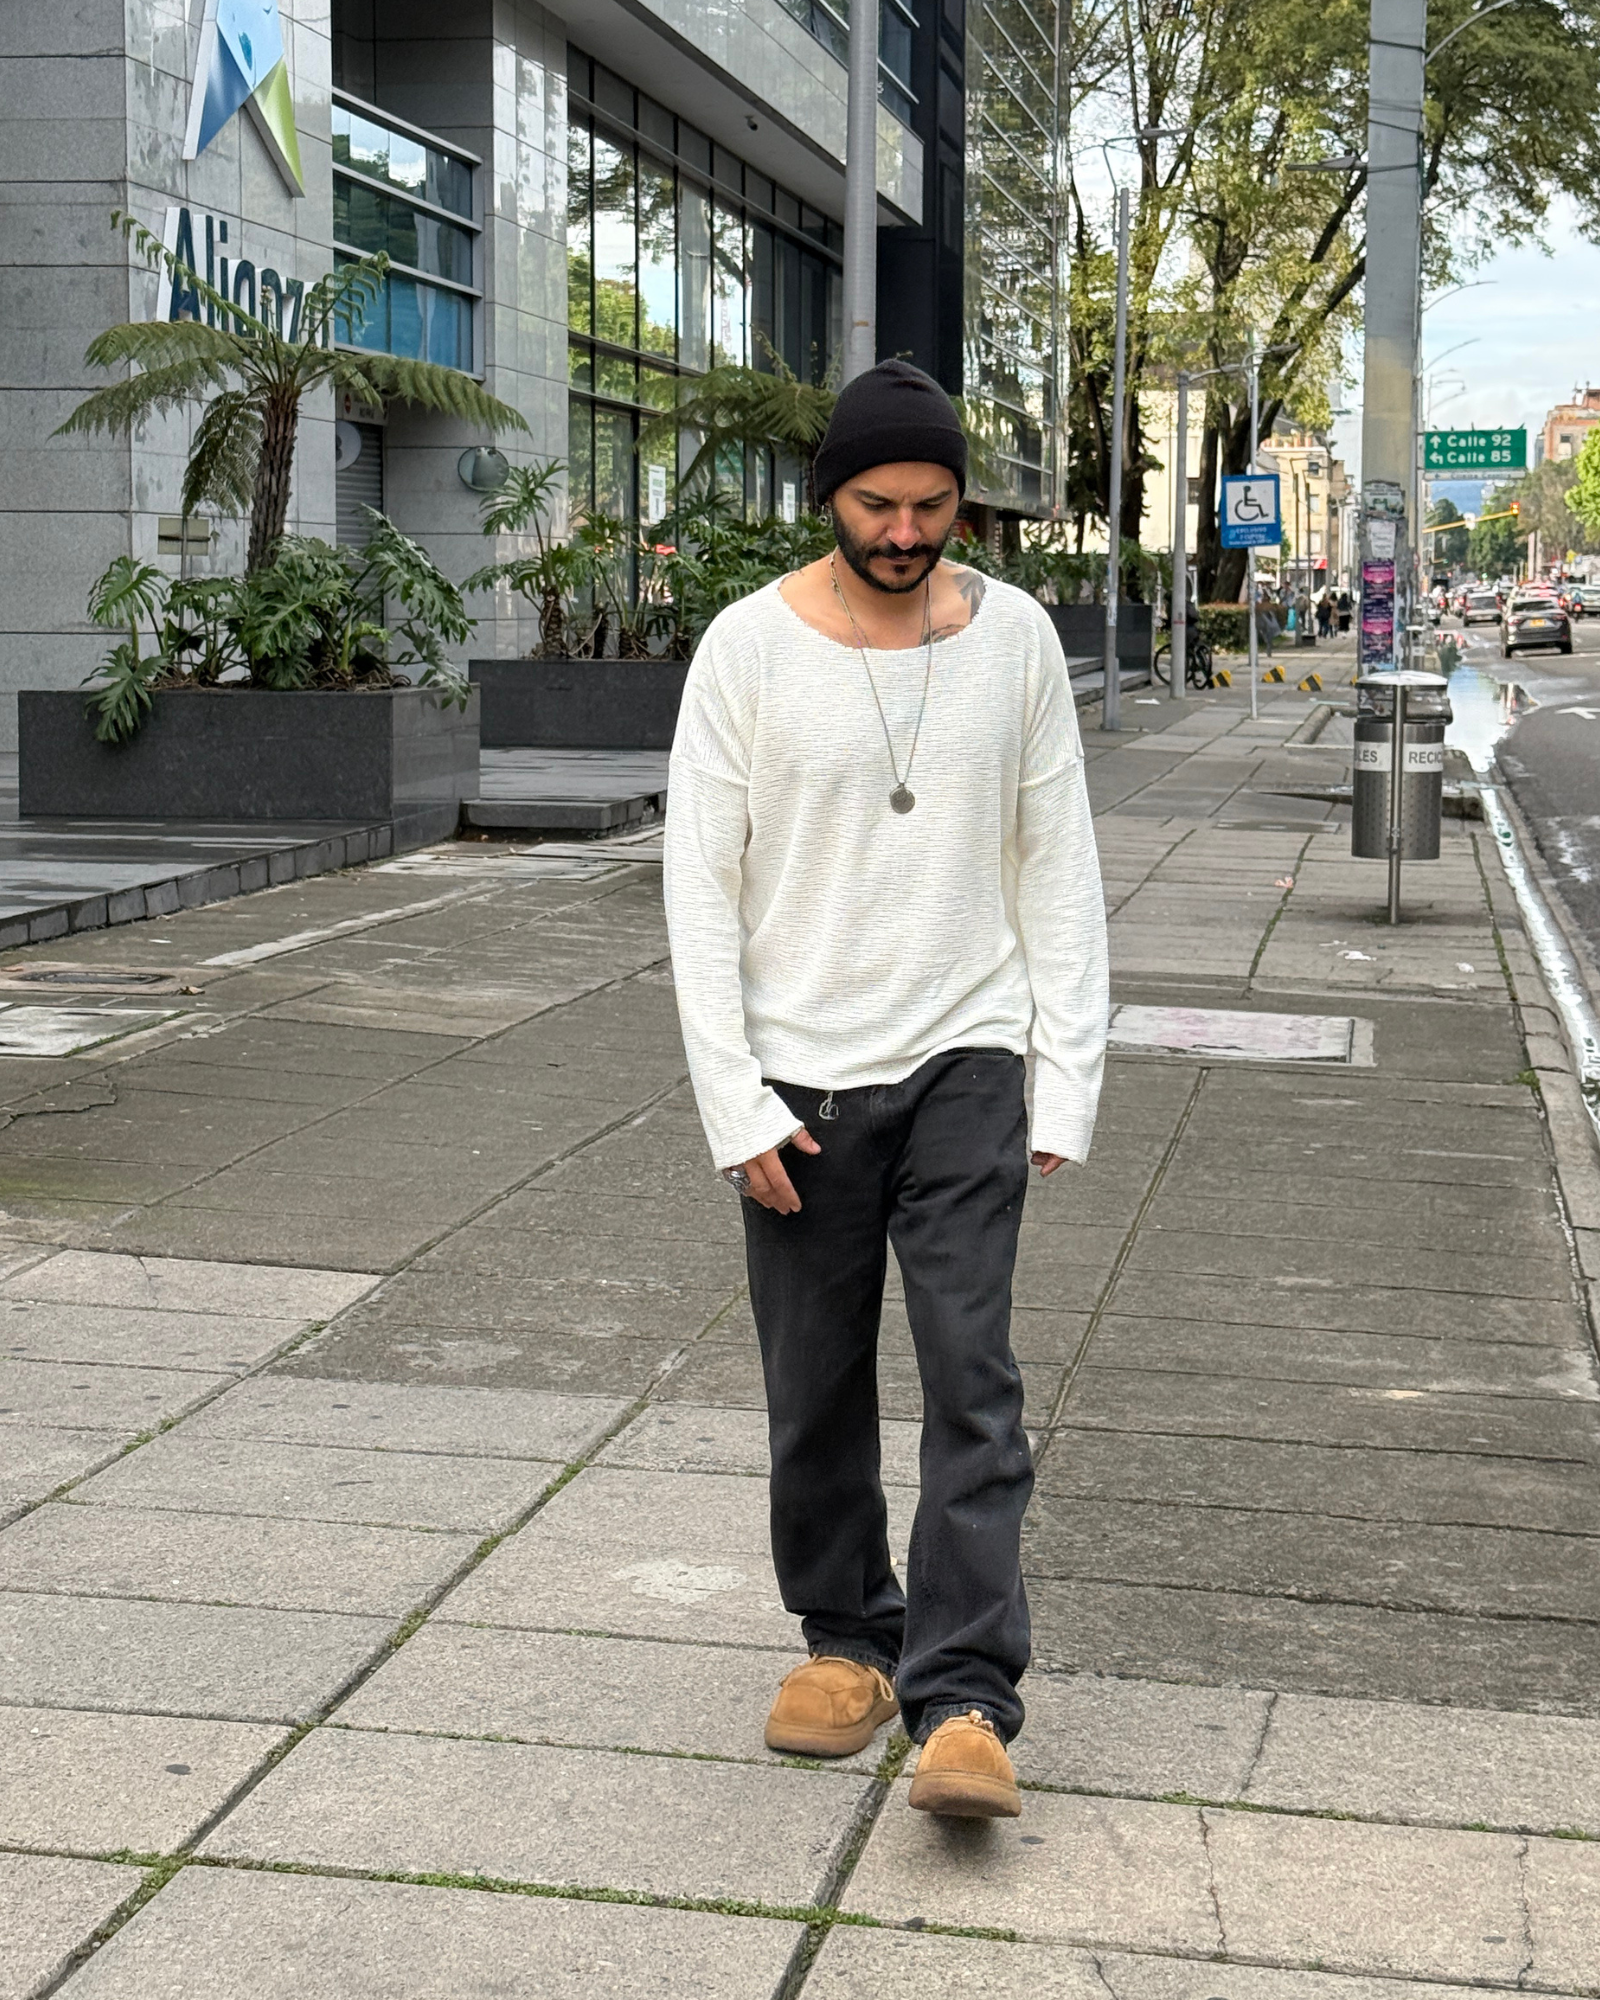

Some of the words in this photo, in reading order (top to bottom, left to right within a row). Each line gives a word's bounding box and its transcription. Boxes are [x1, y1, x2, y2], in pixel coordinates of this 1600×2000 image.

[1447, 435, 1487, 447] Calle
[1491, 434, 1512, 447] 92
[1446, 451, 1486, 463] Calle
[1490, 450, 1512, 463] 85
